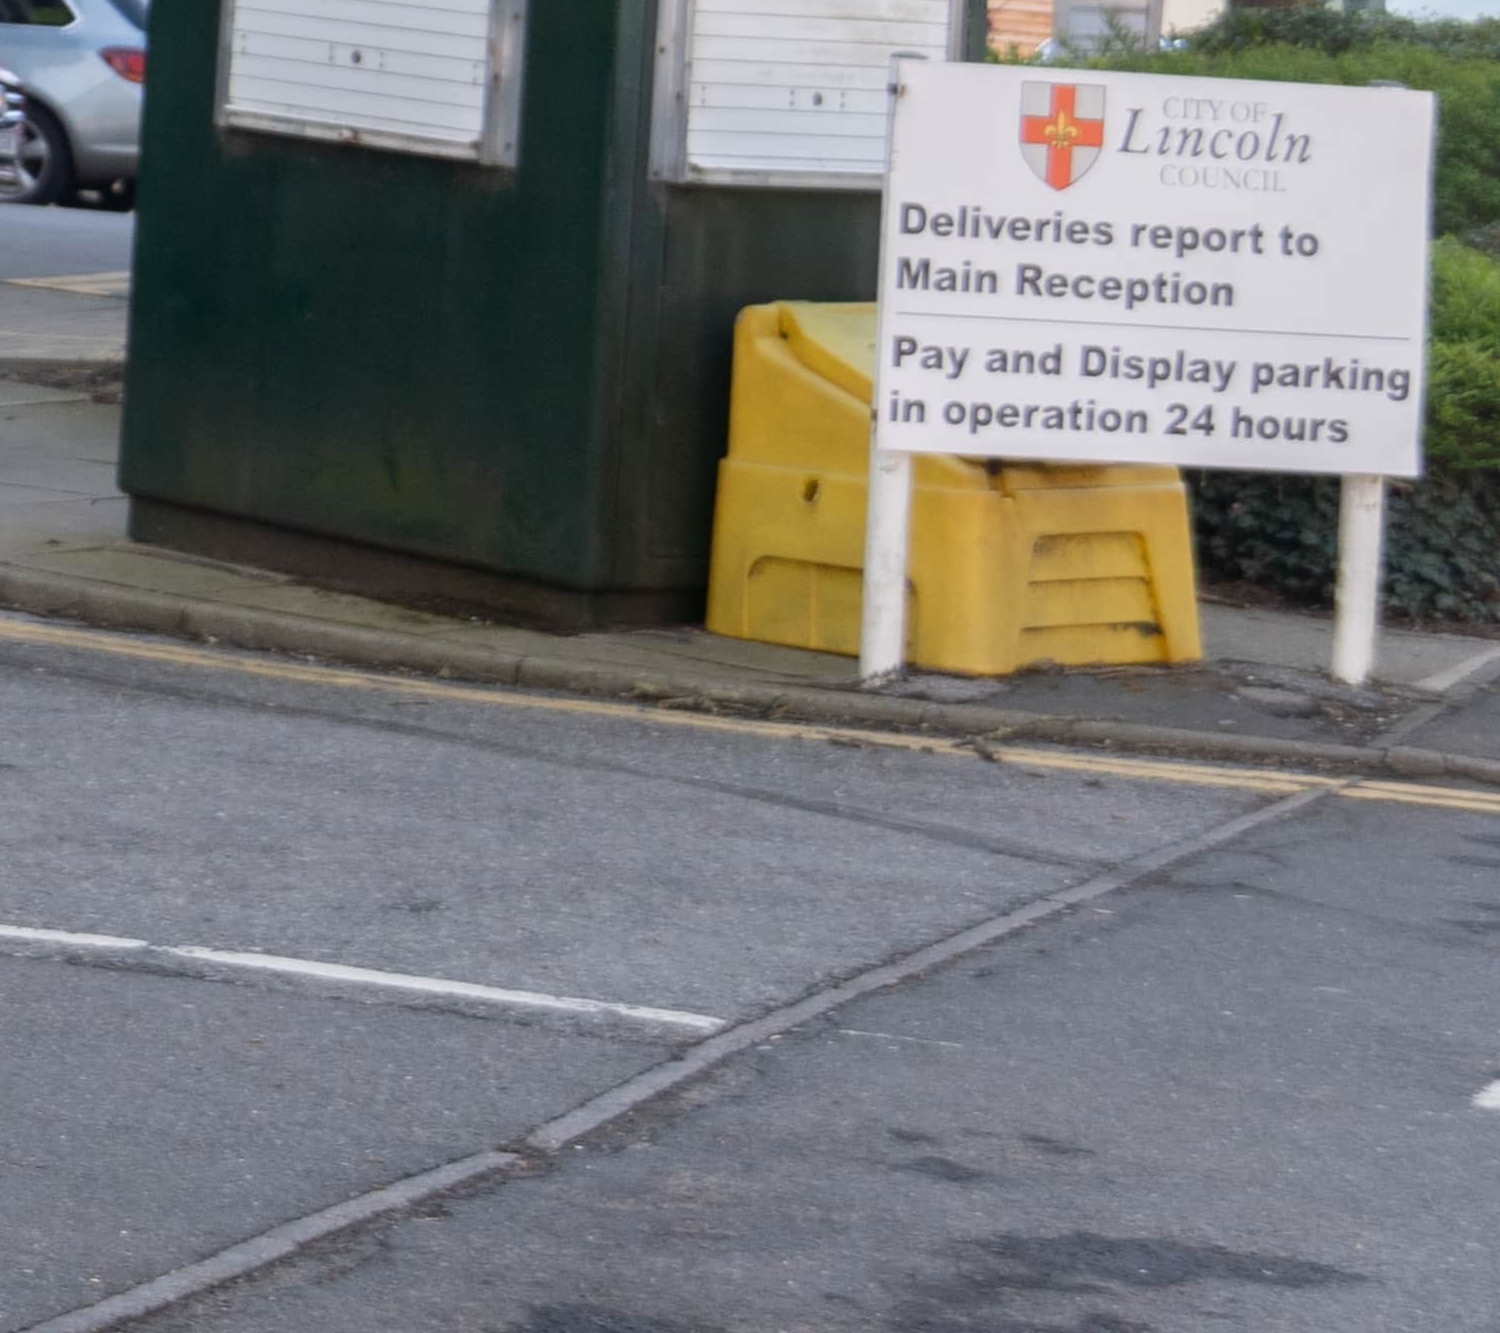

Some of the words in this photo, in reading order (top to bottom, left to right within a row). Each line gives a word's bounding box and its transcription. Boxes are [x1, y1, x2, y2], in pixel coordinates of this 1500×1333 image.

[1117, 107, 1313, 164] Lincoln
[1163, 96, 1225, 123] CITY
[1231, 100, 1267, 124] OF
[1159, 163, 1288, 193] COUNCIL
[900, 202, 1115, 246] Deliveries
[1131, 221, 1264, 258] report
[1280, 224, 1319, 257] to
[896, 257, 999, 294] Main
[1016, 264, 1234, 310] Reception
[891, 335, 969, 379] Pay
[985, 344, 1062, 375] and
[1079, 346, 1236, 393] Display
[1252, 358, 1411, 401] parking
[889, 391, 926, 423] in
[942, 396, 1148, 434] operation
[1164, 403, 1215, 436] 24
[1231, 407, 1349, 443] hours
